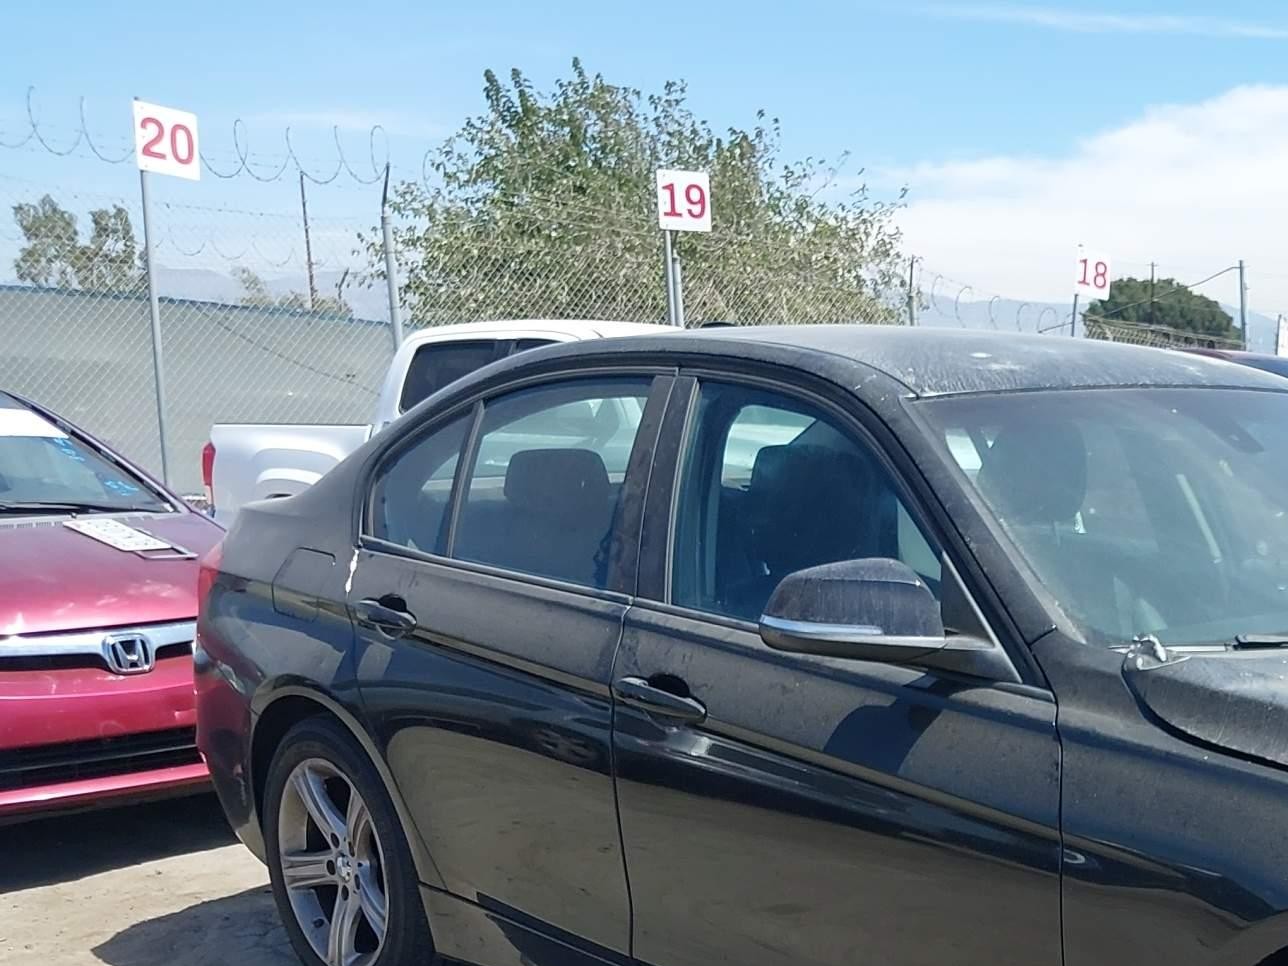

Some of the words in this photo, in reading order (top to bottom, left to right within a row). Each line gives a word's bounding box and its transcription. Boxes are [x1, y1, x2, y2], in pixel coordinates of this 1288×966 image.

[140, 117, 194, 165] 20
[662, 183, 706, 219] 19
[1077, 258, 1107, 289] 18
